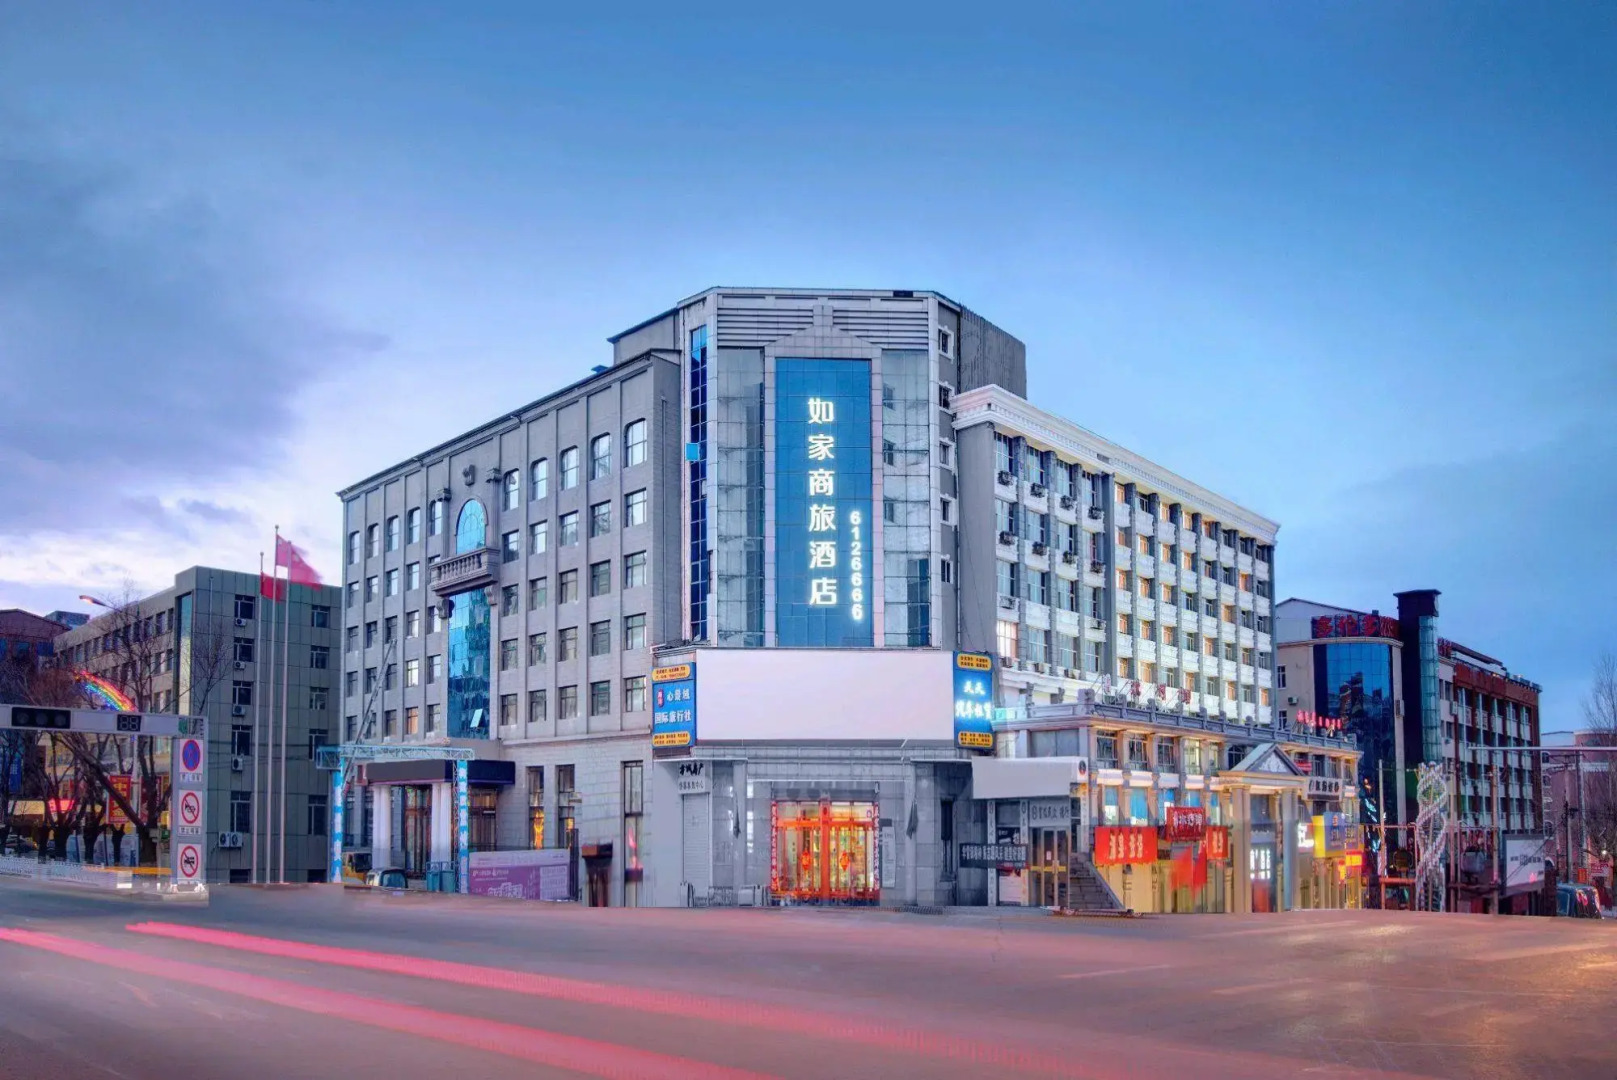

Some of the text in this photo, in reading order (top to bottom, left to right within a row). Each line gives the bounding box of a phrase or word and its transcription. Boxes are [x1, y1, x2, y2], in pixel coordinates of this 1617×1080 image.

[808, 397, 837, 607] 如家商旅酒店
[849, 510, 864, 621] 6126666
[654, 709, 691, 724] 国际旅行社
